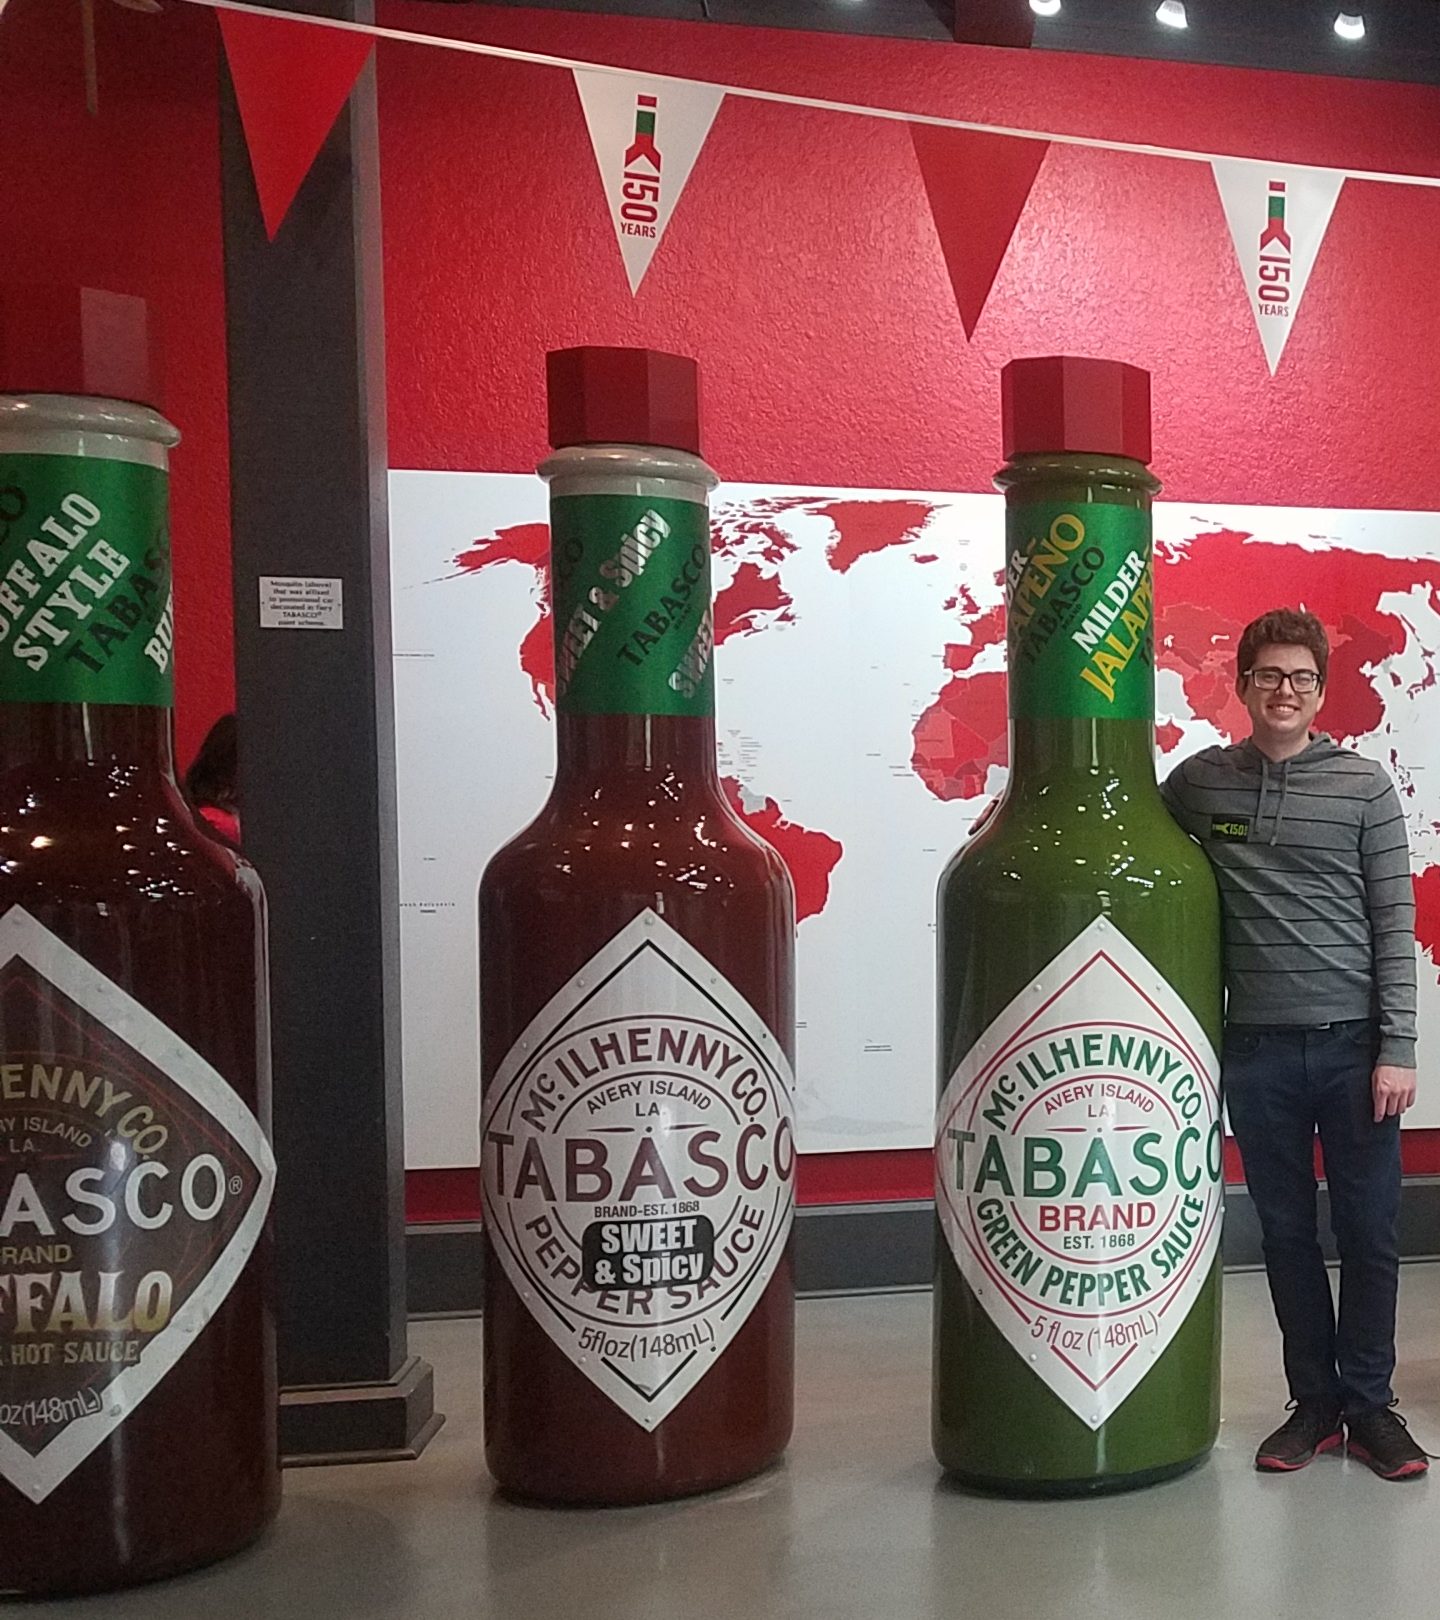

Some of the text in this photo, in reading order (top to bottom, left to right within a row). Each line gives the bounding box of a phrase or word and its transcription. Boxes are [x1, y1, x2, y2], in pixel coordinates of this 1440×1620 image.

[621, 171, 660, 223] 150
[620, 222, 656, 238] YEARS
[1258, 255, 1291, 302] 150
[1258, 303, 1289, 317] YEARS
[13, 539, 131, 671] STYLE
[617, 544, 706, 666] TABASCO
[1072, 550, 1146, 654] MILDER
[586, 1080, 712, 1115] AVERY ISLAND
[1044, 1083, 1155, 1115] AVERY ISLAND
[24, 1116, 92, 1147] ISLAND
[488, 1116, 792, 1202] TABASCO
[948, 1120, 1222, 1198] TABASCO
[672, 1201, 700, 1215] 1868
[1039, 1202, 1156, 1232] BRAND
[601, 1219, 698, 1254] SWEET
[977, 1194, 1204, 1307] GREEN PEPPER SAUCE
[1063, 1233, 1135, 1250] EST. 1868
[594, 1251, 704, 1285] & Spicy
[1031, 1315, 1045, 1338] 5
[11, 1340, 140, 1366] HOT SAUCE
